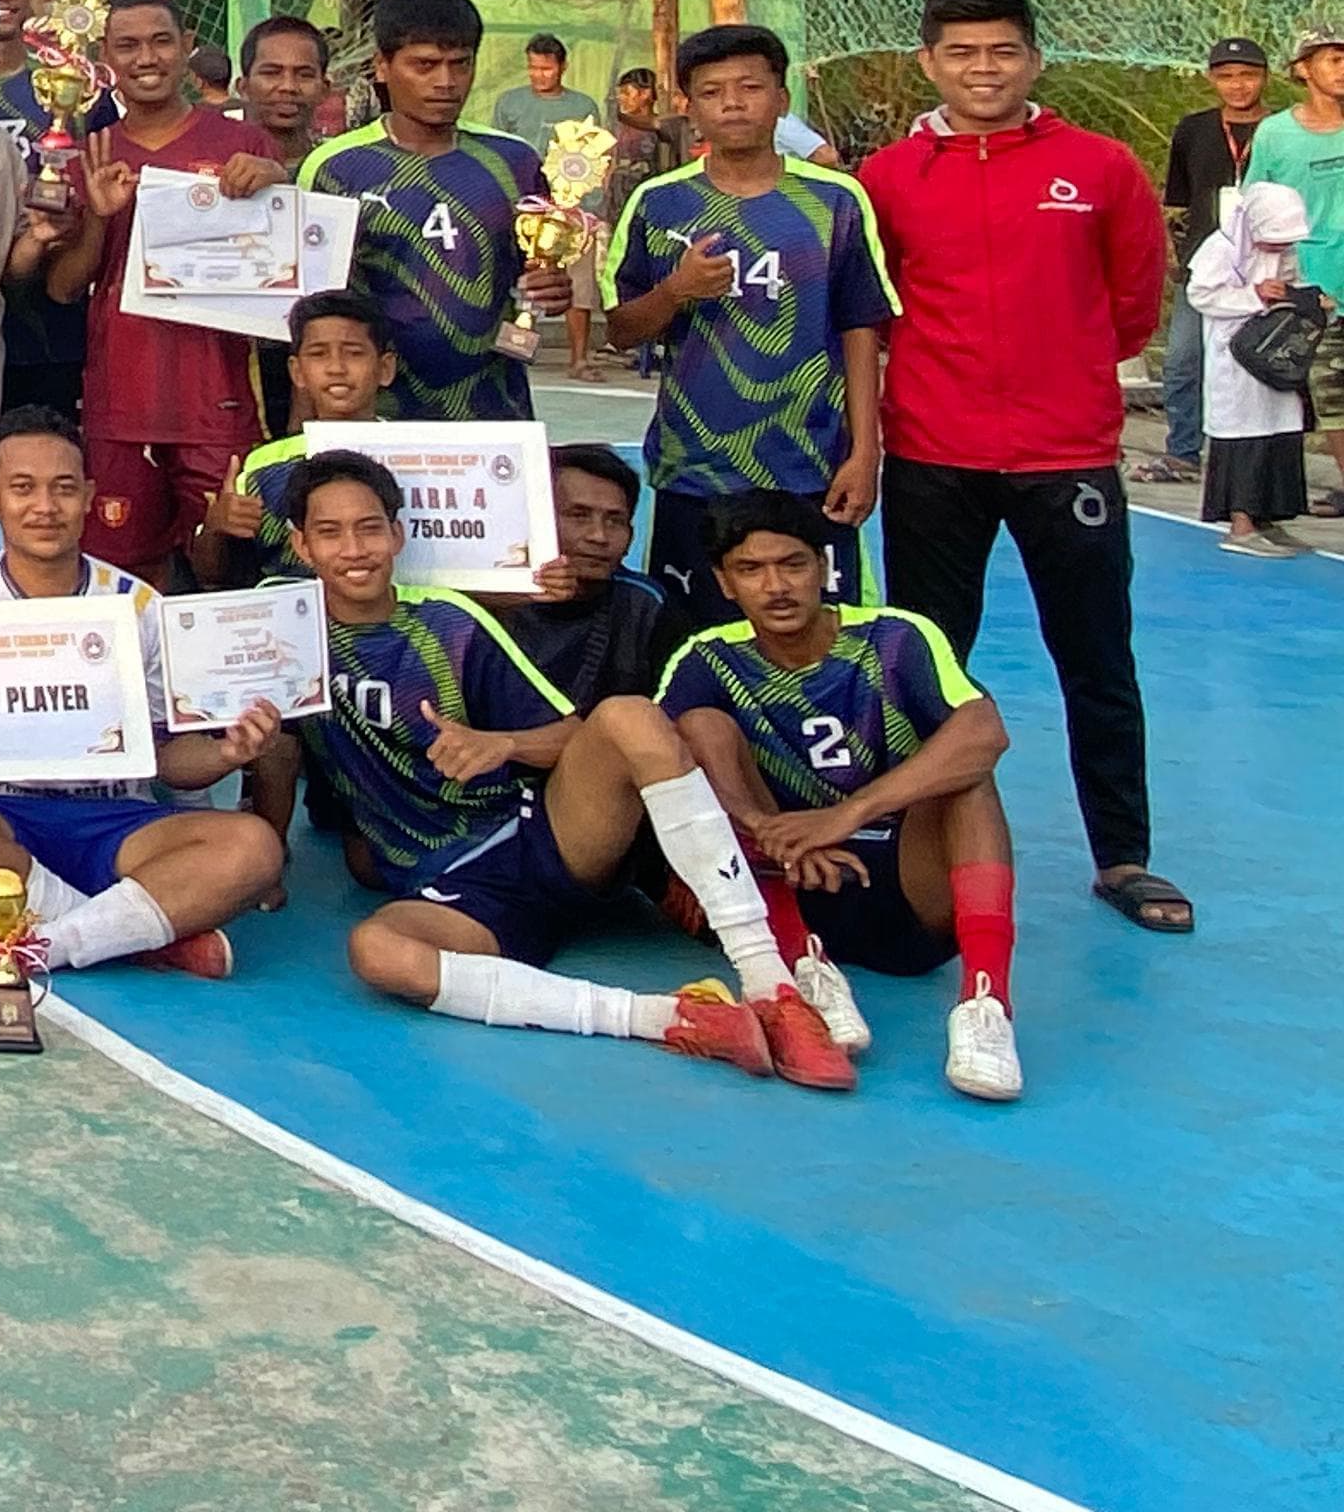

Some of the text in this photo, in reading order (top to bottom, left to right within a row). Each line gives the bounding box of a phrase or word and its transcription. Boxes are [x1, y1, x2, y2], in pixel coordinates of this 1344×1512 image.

[422, 203, 458, 250] 4
[724, 249, 785, 300] 14
[410, 488, 488, 510] ARA 4
[409, 519, 487, 539] 750.000
[6, 684, 91, 713] PLAYER
[800, 715, 851, 769] 2
